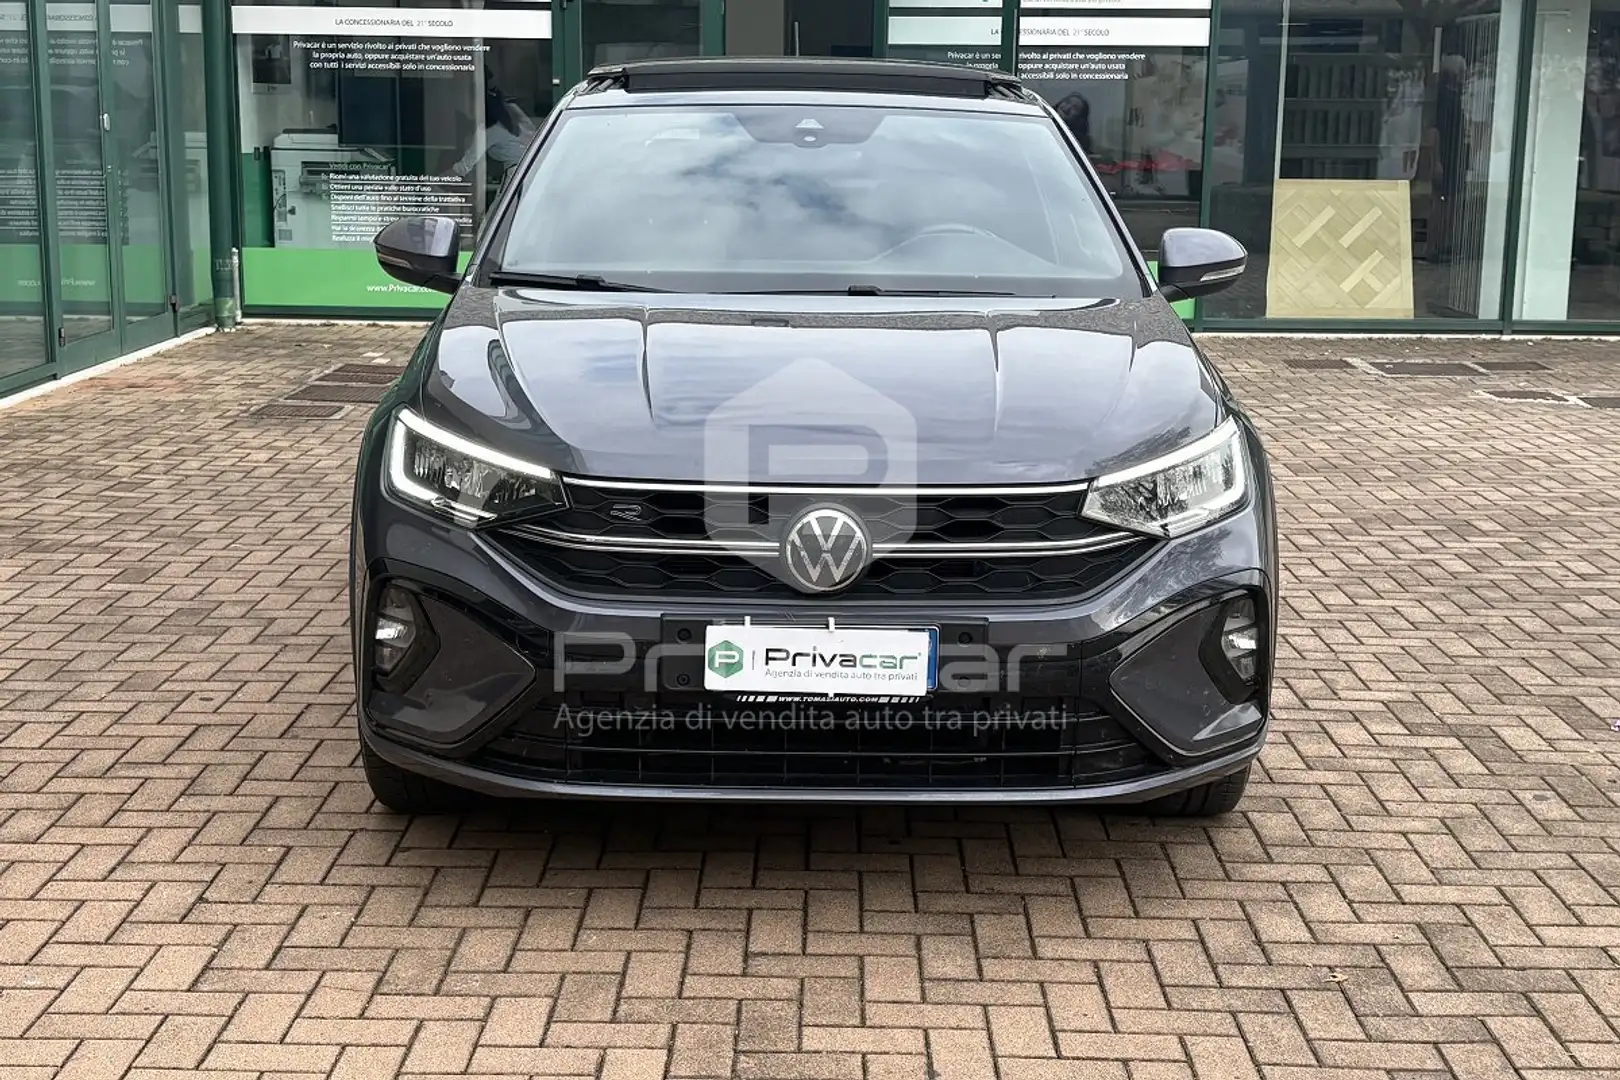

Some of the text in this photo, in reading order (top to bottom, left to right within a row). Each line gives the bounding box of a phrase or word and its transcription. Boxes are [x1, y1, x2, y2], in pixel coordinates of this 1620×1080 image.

[293, 41, 320, 49] Privacar
[338, 42, 363, 50] servizio
[364, 42, 387, 50] rivolto
[388, 42, 394, 50] ai
[395, 42, 417, 51] privati
[418, 43, 430, 51] che
[431, 43, 462, 52] vogliono
[463, 44, 491, 52] vendere
[320, 52, 345, 60] propria
[390, 53, 425, 61] acquistare
[947, 51, 974, 59] Privacar
[1019, 52, 1041, 60] rivolto
[1049, 52, 1071, 61] privati
[1072, 52, 1085, 60] che
[1086, 52, 1116, 61] vogliono
[324, 61, 338, 69] tutti
[367, 62, 401, 70] accessibili
[402, 62, 417, 70] solo
[425, 63, 475, 71] concessionaria
[1018, 62, 1043, 71] oppure
[1044, 62, 1079, 71] acquistare
[1020, 72, 1054, 80] accessibili
[1079, 72, 1128, 80] concessionaria
[765, 668, 918, 681] Agenzia di vendita auto tra privati
